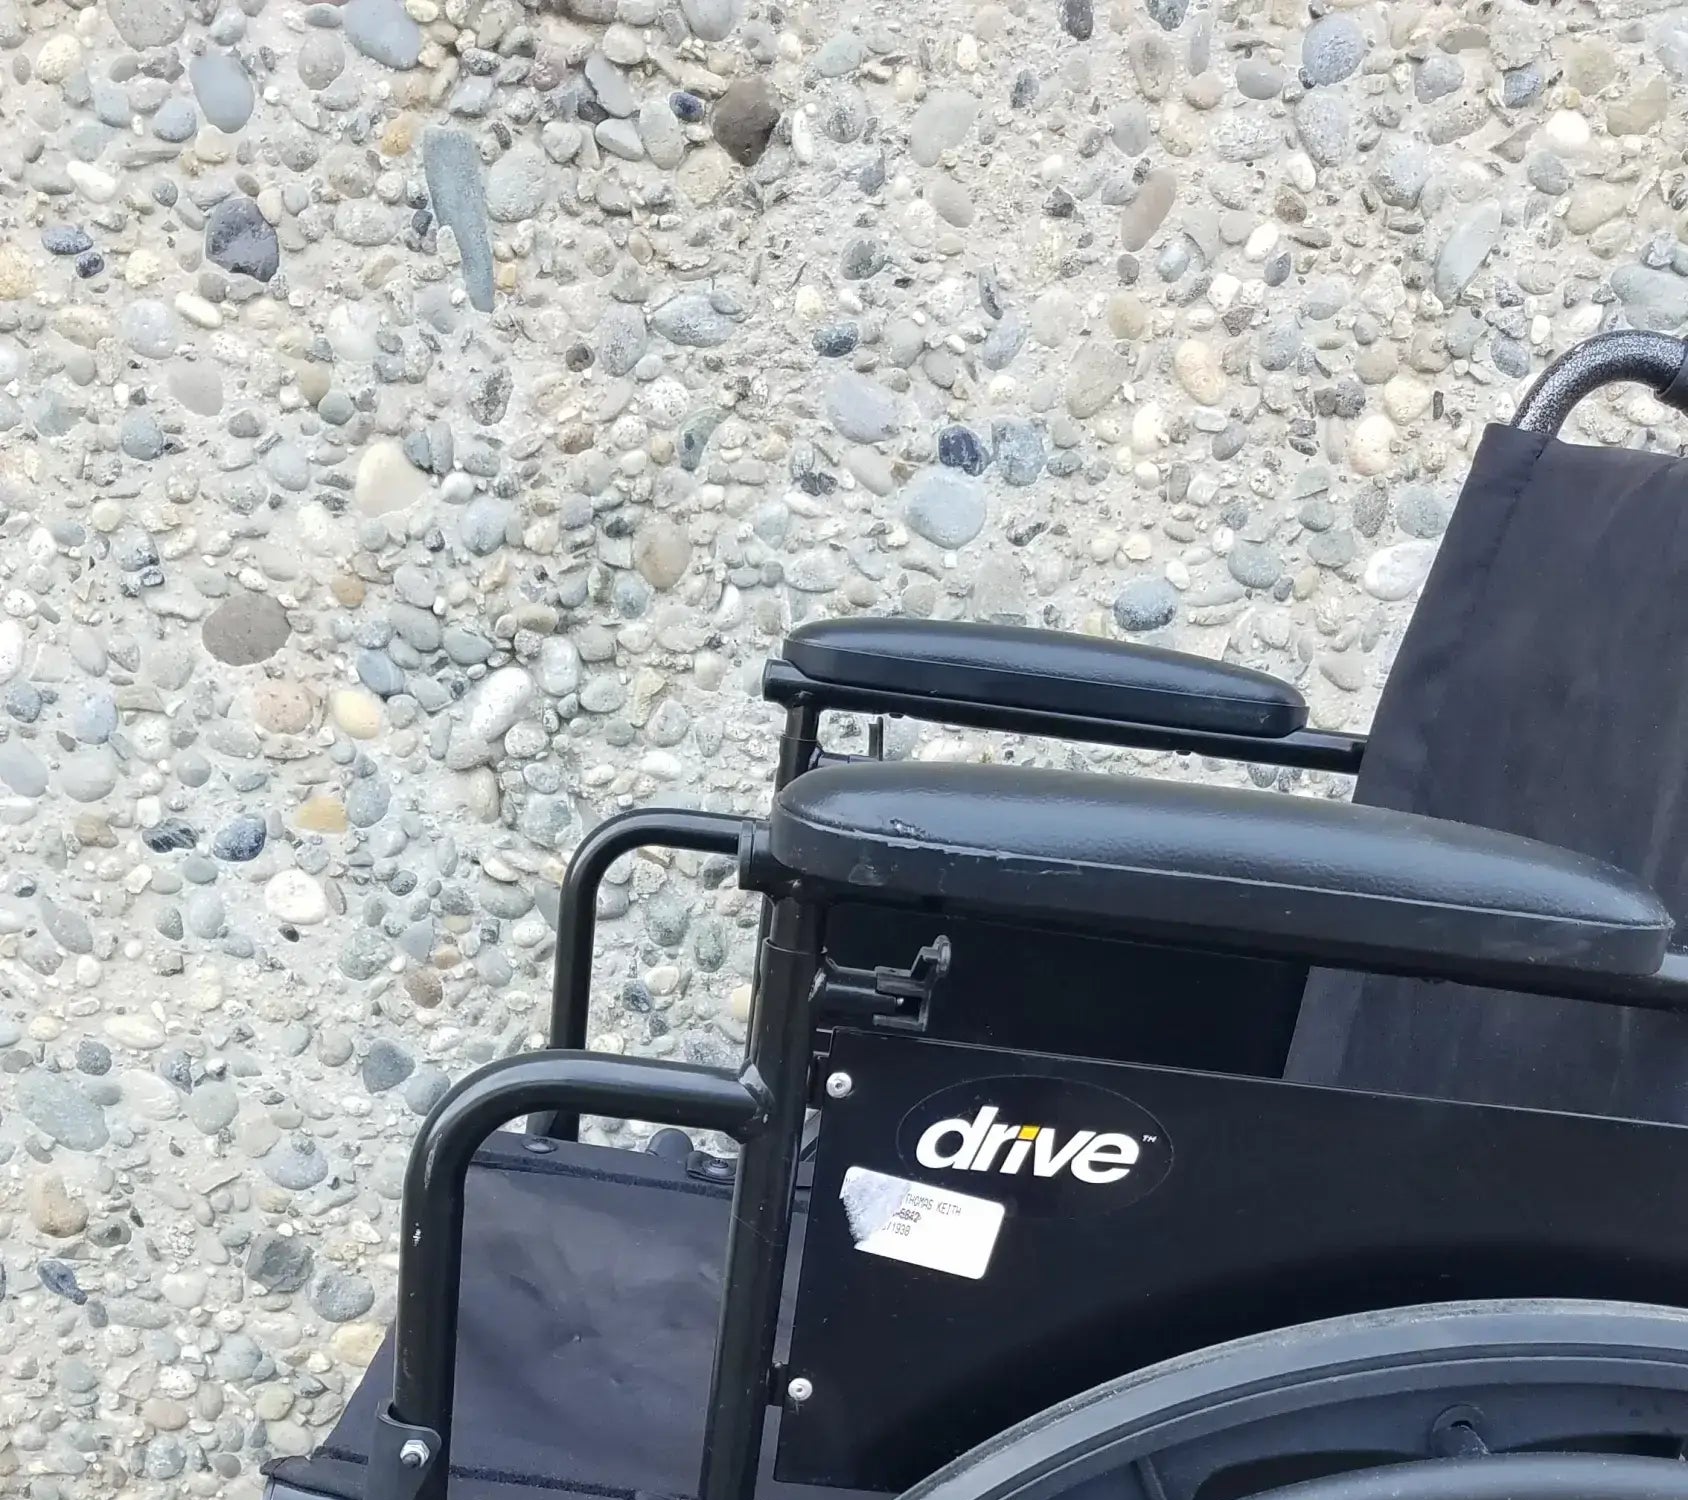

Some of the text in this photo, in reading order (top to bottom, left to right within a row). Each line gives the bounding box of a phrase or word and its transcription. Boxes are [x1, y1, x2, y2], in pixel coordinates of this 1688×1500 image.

[916, 1105, 1140, 1184] drive
[905, 1192, 962, 1216] THOMAS KEITH
